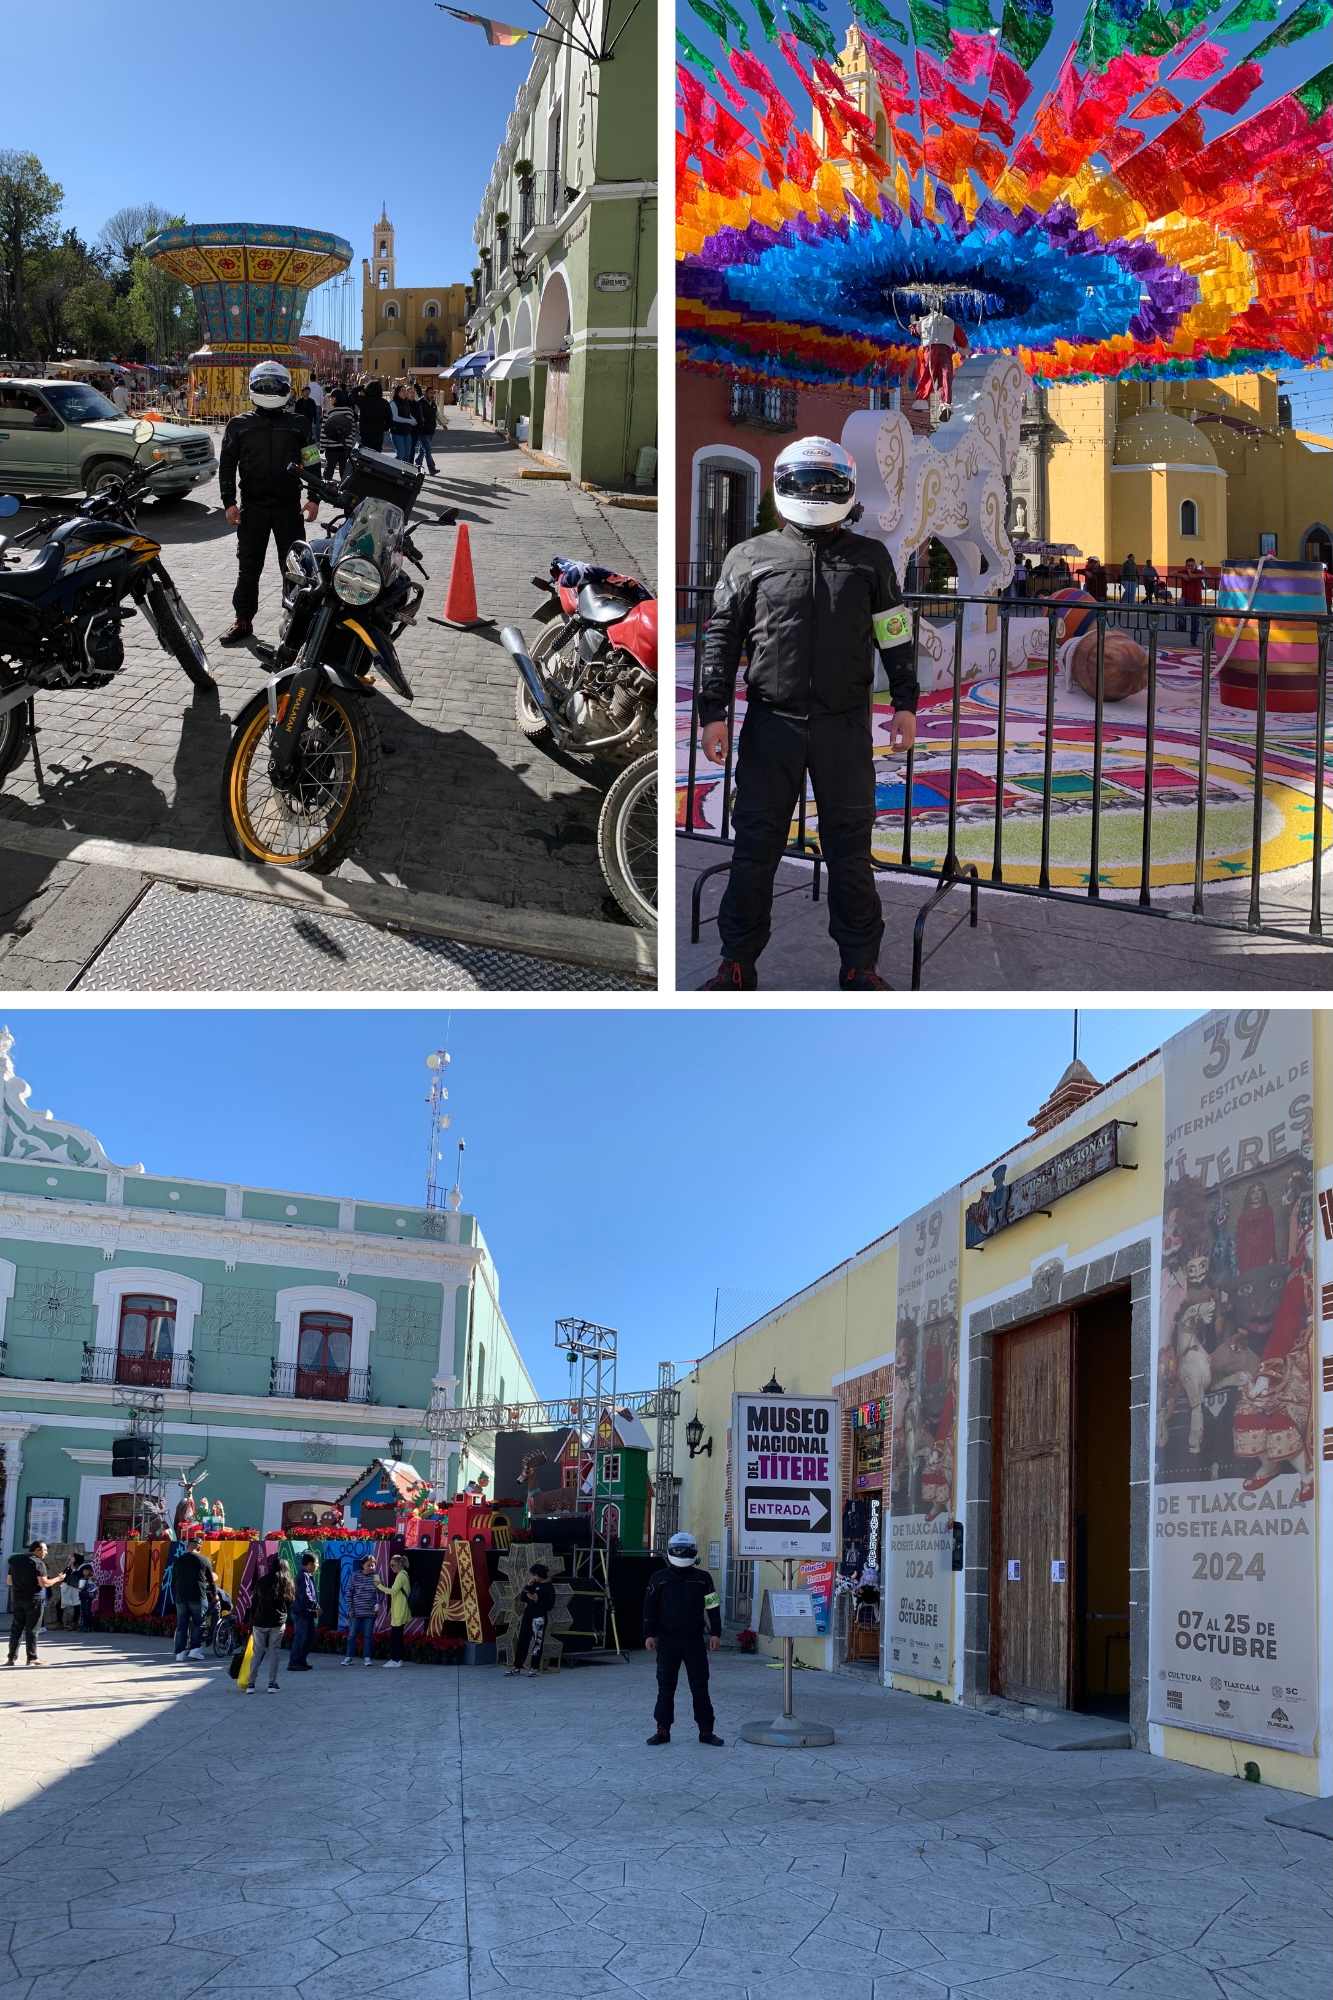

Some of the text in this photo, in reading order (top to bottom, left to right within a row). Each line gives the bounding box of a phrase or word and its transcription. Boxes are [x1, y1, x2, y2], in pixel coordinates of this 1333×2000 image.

[286, 687, 306, 733] HIMALAYAN
[1202, 1008, 1270, 1079] 39
[1200, 1063, 1267, 1110] FESTIVAL
[1166, 1060, 1309, 1148] INTERNACIONAL DE
[1057, 1133, 1111, 1174] NACIONAL
[914, 1210, 943, 1257] 39
[898, 1257, 958, 1296] INTERNIONAL DE
[914, 1253, 941, 1275] FESIVAL
[747, 1406, 829, 1434] MUSEO
[747, 1434, 829, 1454] NACIONAL
[747, 1453, 829, 1481] DEL TÍTERE
[749, 1503, 811, 1516] ENTRADA
[1157, 1488, 1307, 1515] DE TLAXCALA
[893, 1525, 904, 1536] DE
[1155, 1517, 1310, 1537] ROSETE ARANDA
[915, 1539, 951, 1551] ARANDA
[1191, 1552, 1266, 1581] 2024
[898, 1611, 938, 1627] OCTUBRE
[916, 1599, 926, 1612] 25
[928, 1604, 937, 1613] DE
[1178, 1610, 1275, 1637] 07 AL 25 DE
[1175, 1631, 1277, 1660] OCTUBRE
[1168, 1671, 1202, 1683] CULTURA
[1223, 1680, 1260, 1693] TLAXCALA
[1286, 1687, 1299, 1696] SC
